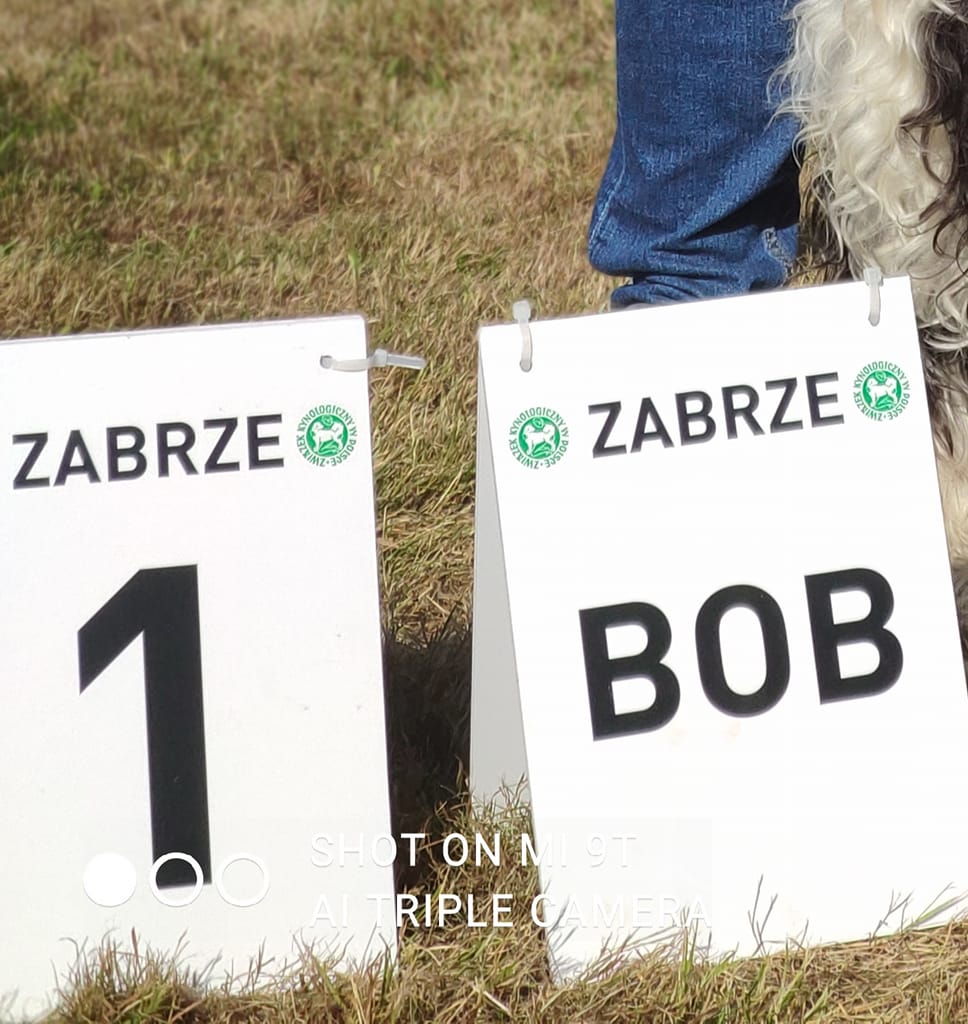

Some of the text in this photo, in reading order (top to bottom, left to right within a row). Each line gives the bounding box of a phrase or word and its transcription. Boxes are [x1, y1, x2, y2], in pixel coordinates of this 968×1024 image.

[12, 413, 285, 490] ZABRZE
[588, 372, 845, 459] ZABRZE
[578, 567, 904, 742] BOB
[77, 564, 212, 890] 1
